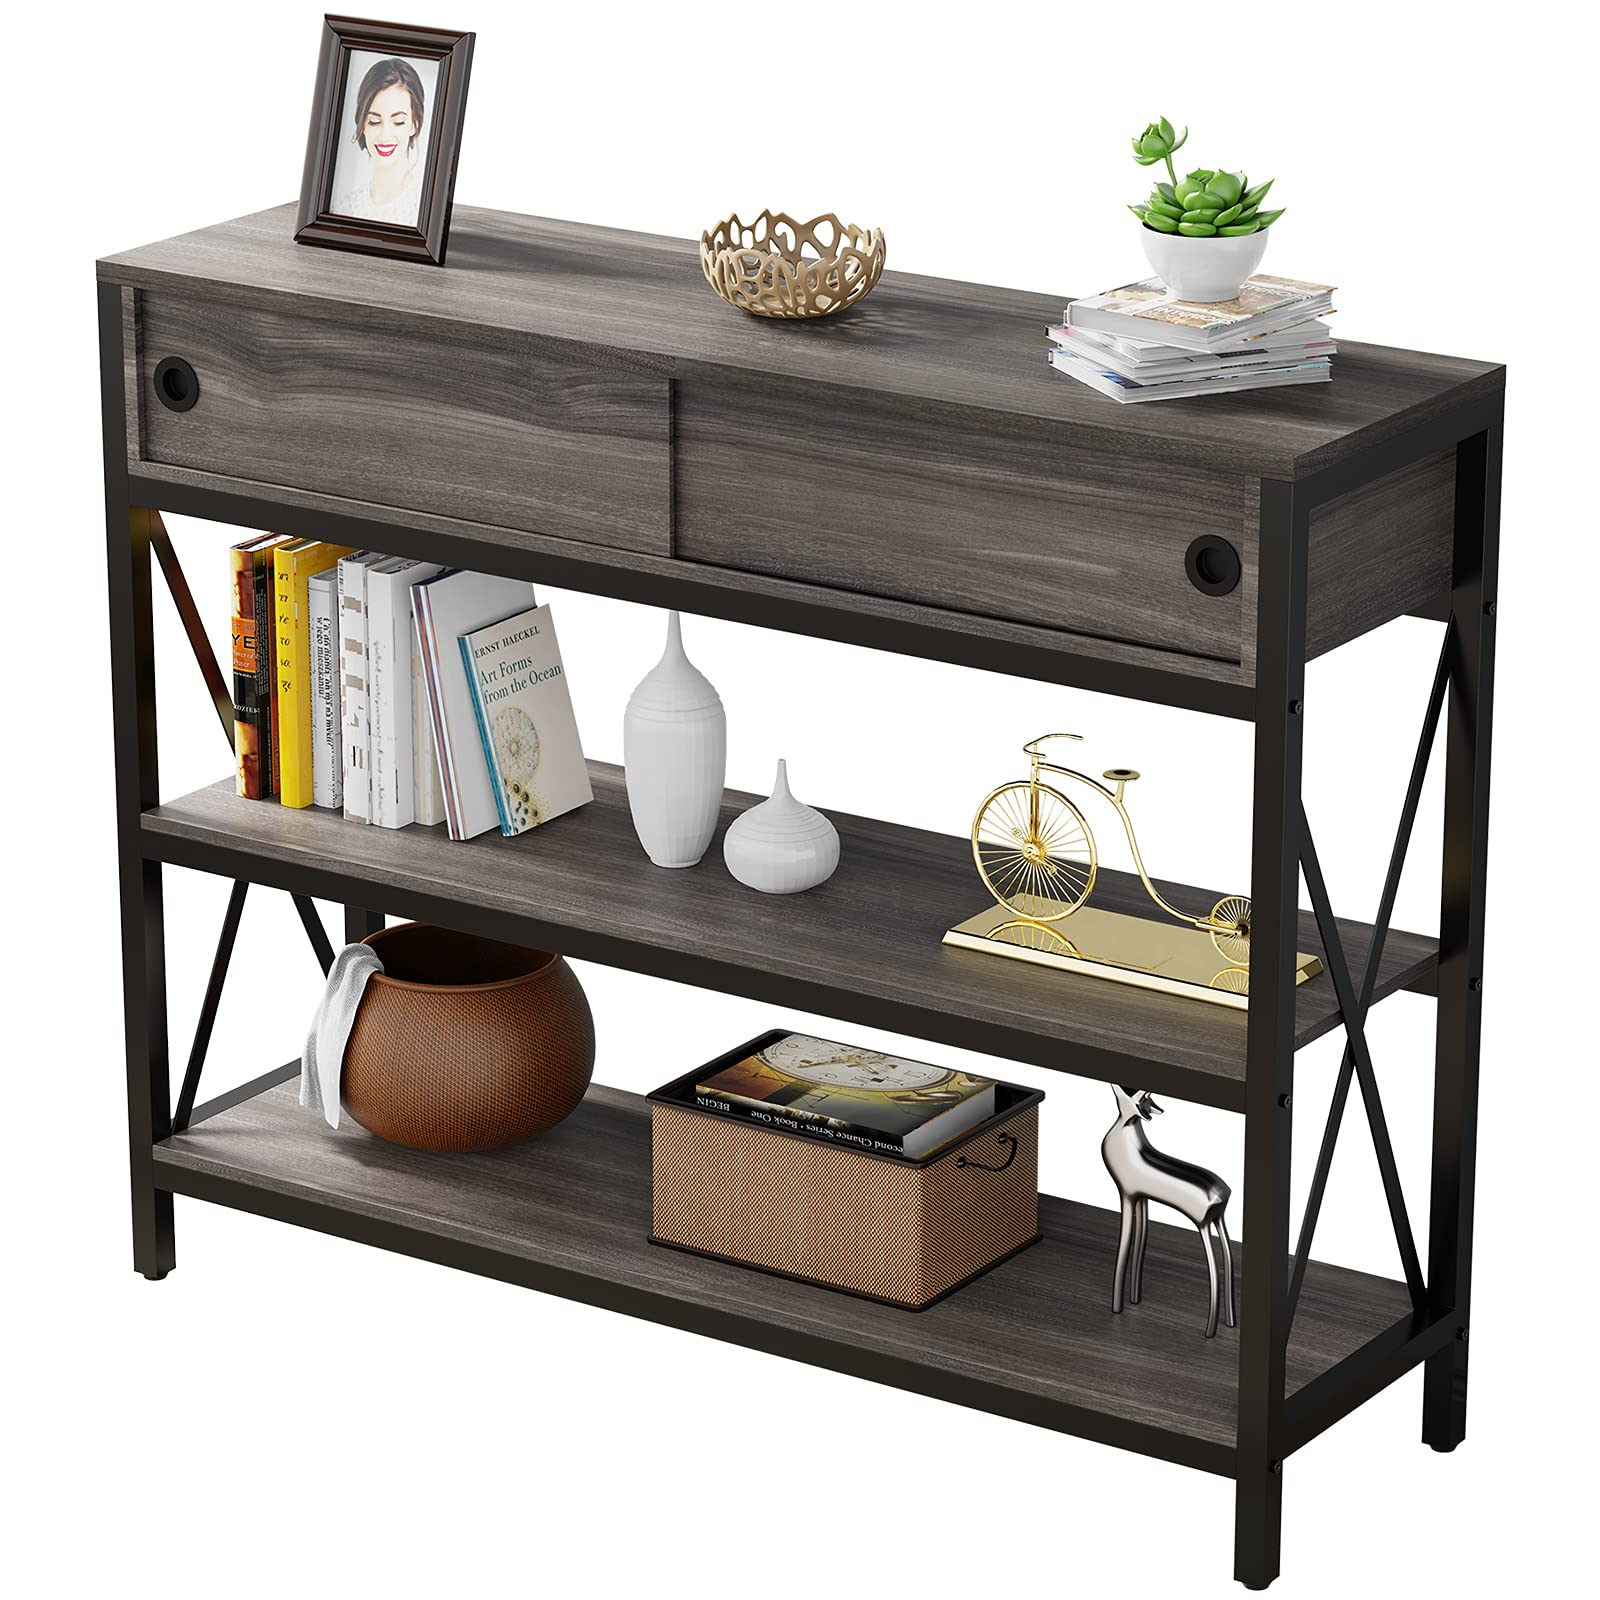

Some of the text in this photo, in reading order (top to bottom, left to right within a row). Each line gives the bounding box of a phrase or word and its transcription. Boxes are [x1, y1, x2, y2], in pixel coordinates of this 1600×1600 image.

[474, 625, 541, 659] ERNST HAECKEL
[480, 656, 533, 686] Art Forms
[483, 665, 562, 704] from the Ocean
[696, 1096, 731, 1112] BEGIN
[750, 1110, 772, 1123] One
[773, 1115, 798, 1129] Book
[805, 1123, 834, 1138] Series
[836, 1131, 873, 1147] Chance
